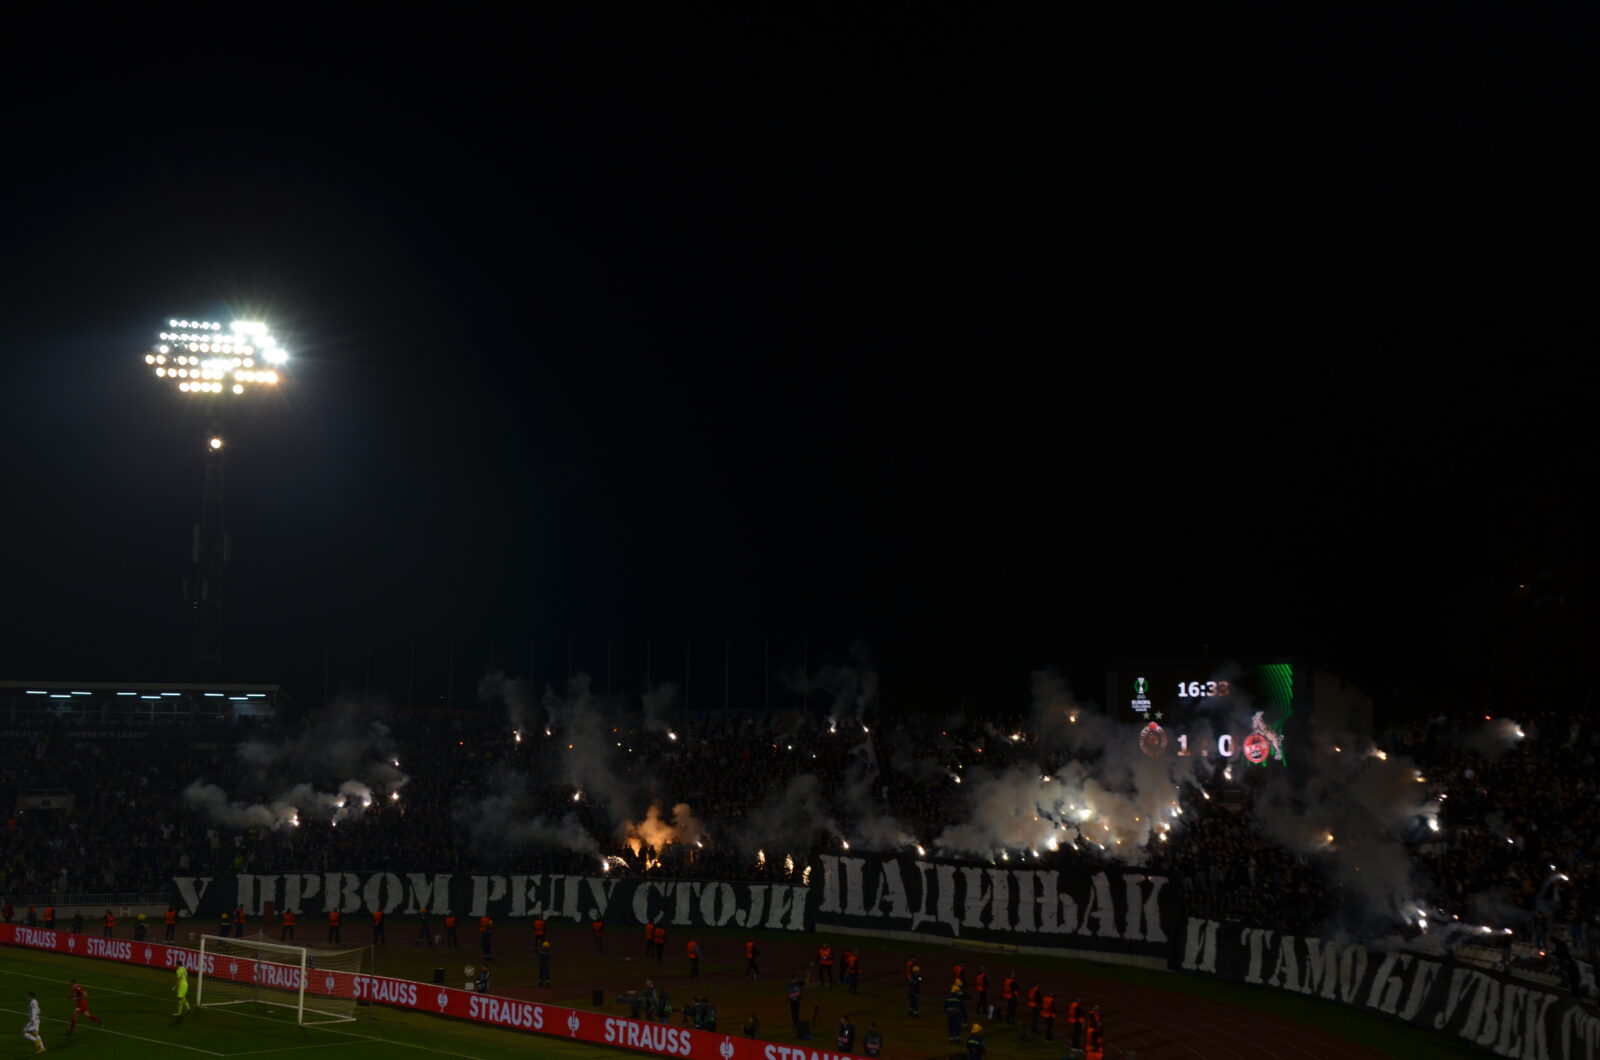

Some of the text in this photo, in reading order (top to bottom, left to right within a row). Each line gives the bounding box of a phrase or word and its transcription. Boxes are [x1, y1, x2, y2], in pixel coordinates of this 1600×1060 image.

[1217, 734, 1235, 757] 0
[172, 854, 1170, 944] У ПРВОМ РЕДУ СТОЈИ ПАДИЊАК
[15, 927, 57, 950] STRAUSS
[87, 938, 132, 961] STRAUSS
[165, 950, 215, 975] STRAUSS
[253, 963, 308, 990] STRAUSS
[353, 975, 418, 1006] STRAUSS
[1181, 917, 1221, 974] И
[1240, 928, 1368, 1004] ТАМО
[1434, 968, 1559, 1060] УВЕК
[469, 995, 544, 1029] STRAUSS
[604, 1018, 691, 1057] STRAUSS
